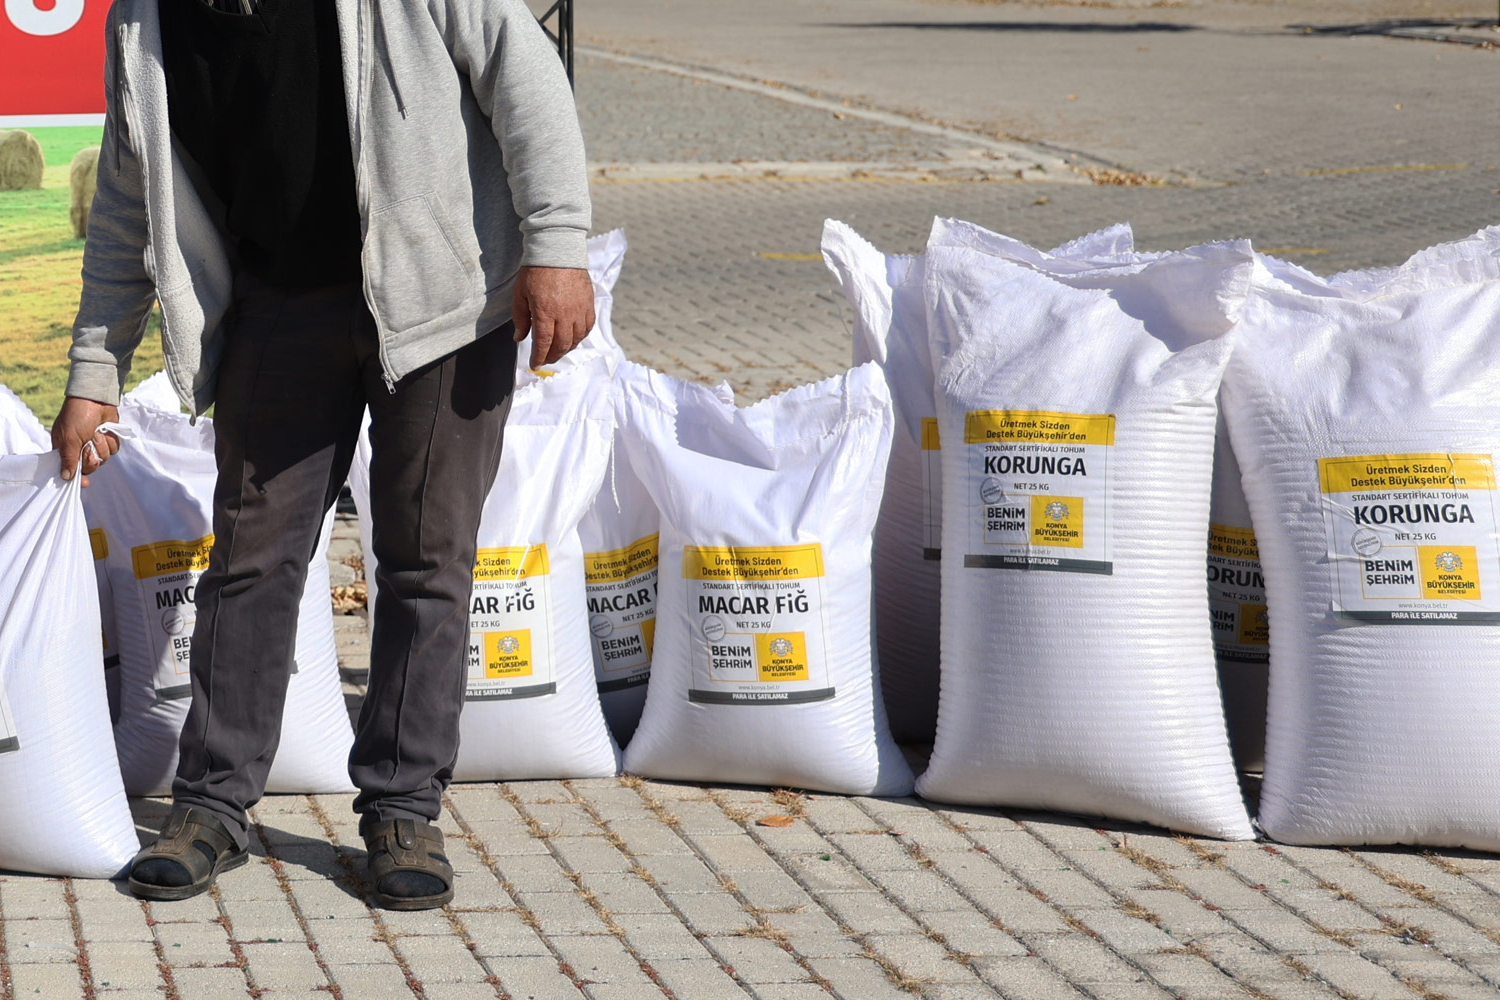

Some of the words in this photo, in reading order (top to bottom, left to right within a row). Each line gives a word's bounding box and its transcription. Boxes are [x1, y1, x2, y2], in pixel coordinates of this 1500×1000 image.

[1001, 420, 1037, 428] Üretmek
[1040, 421, 1070, 430] Sizden
[987, 430, 1014, 438] Destek
[984, 456, 1086, 476] KORUNGA
[1366, 464, 1410, 474] Üretmek
[1413, 464, 1446, 473] Sizden
[1351, 477, 1386, 487] Destek
[1352, 493, 1391, 501] STANDART
[1354, 504, 1475, 525] KORUNGA
[156, 559, 183, 571] Destek
[483, 558, 510, 566] Sizden
[594, 559, 628, 569] Üretmek
[715, 555, 750, 565] Üretmek
[702, 567, 730, 576] Destek
[158, 574, 187, 585] STANDART
[156, 586, 194, 609] MAC
[700, 596, 770, 614] MACAR
[645, 608, 653, 616] KG
